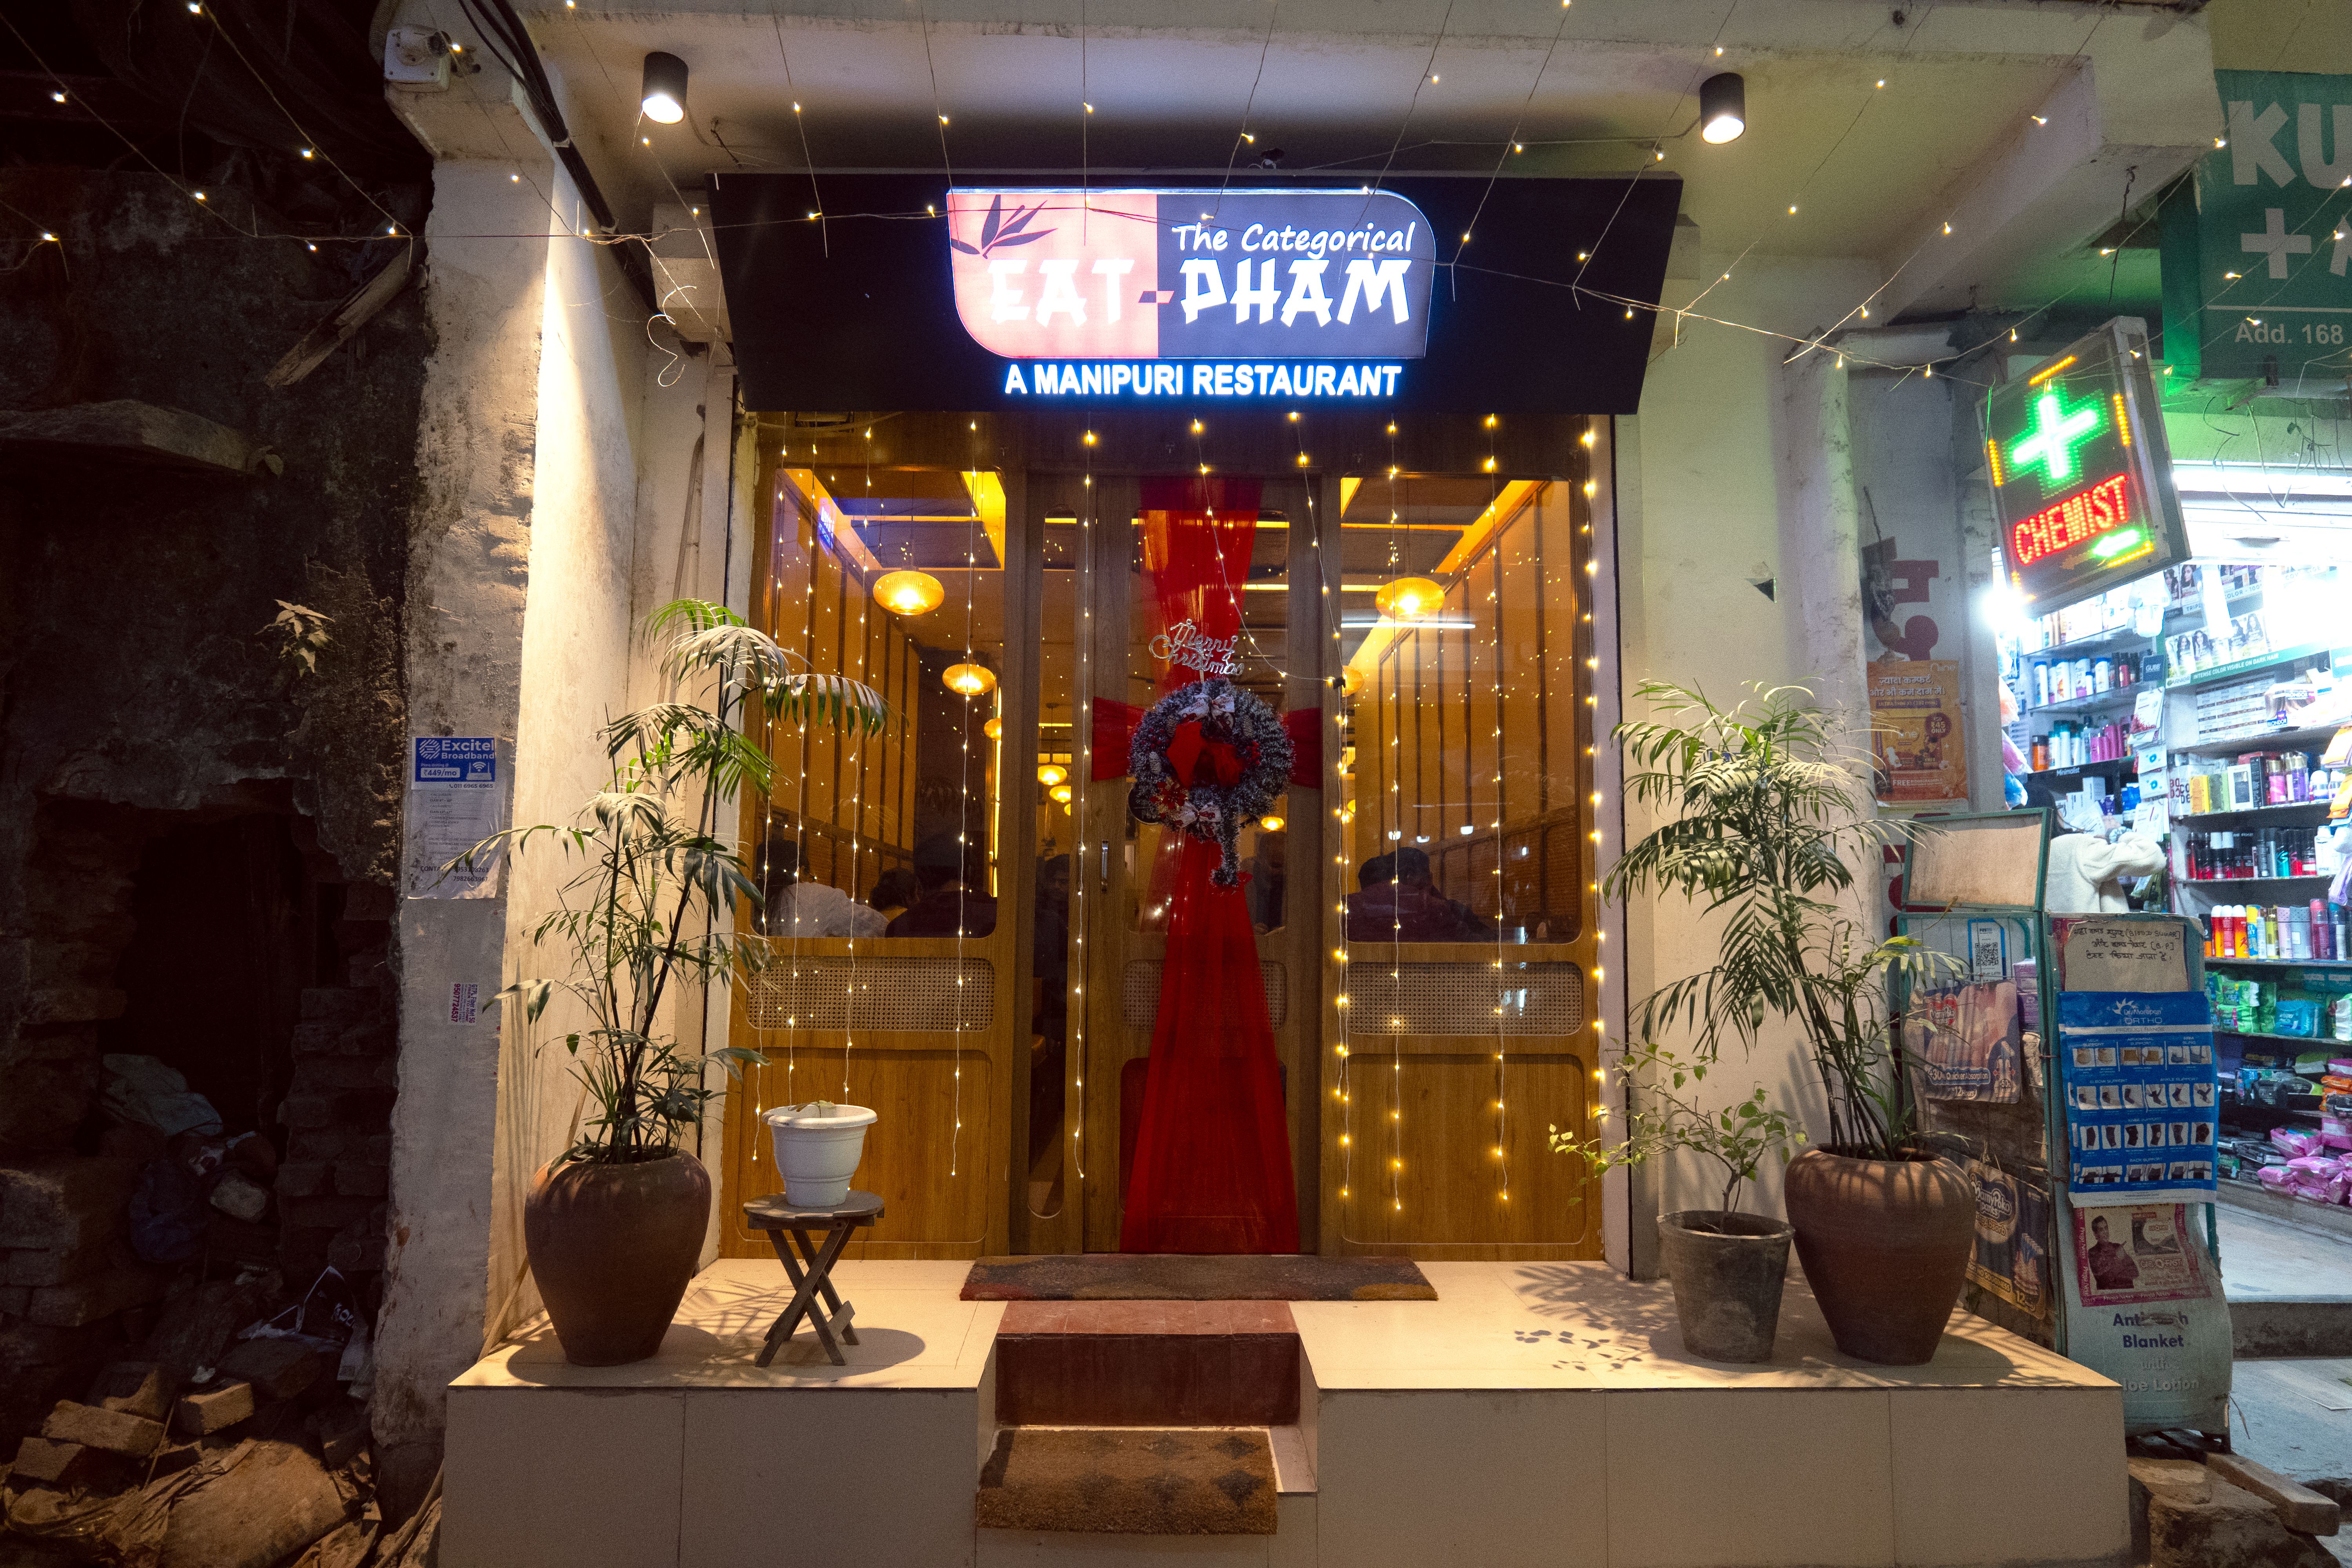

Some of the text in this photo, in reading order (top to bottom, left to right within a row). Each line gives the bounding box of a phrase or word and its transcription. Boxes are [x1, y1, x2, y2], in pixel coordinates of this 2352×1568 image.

[1172, 220, 1417, 260] The Categorical
[2235, 321, 2344, 345] Add. 168
[1005, 365, 1402, 396] A MANIPURI RESTAURANT
[2014, 473, 2128, 567] CHEMIST
[1149, 634, 1244, 676] Christmas
[1170, 622, 1238, 661] Merry
[2193, 671, 2211, 680] INTENSE
[2267, 653, 2279, 661] HAIR
[1898, 688, 1915, 696] कम
[1916, 687, 1933, 695] दाम
[442, 739, 494, 751] Excitel
[2123, 1334, 2184, 1348] Blanket
[2116, 1378, 2200, 1392] loe Lotion
